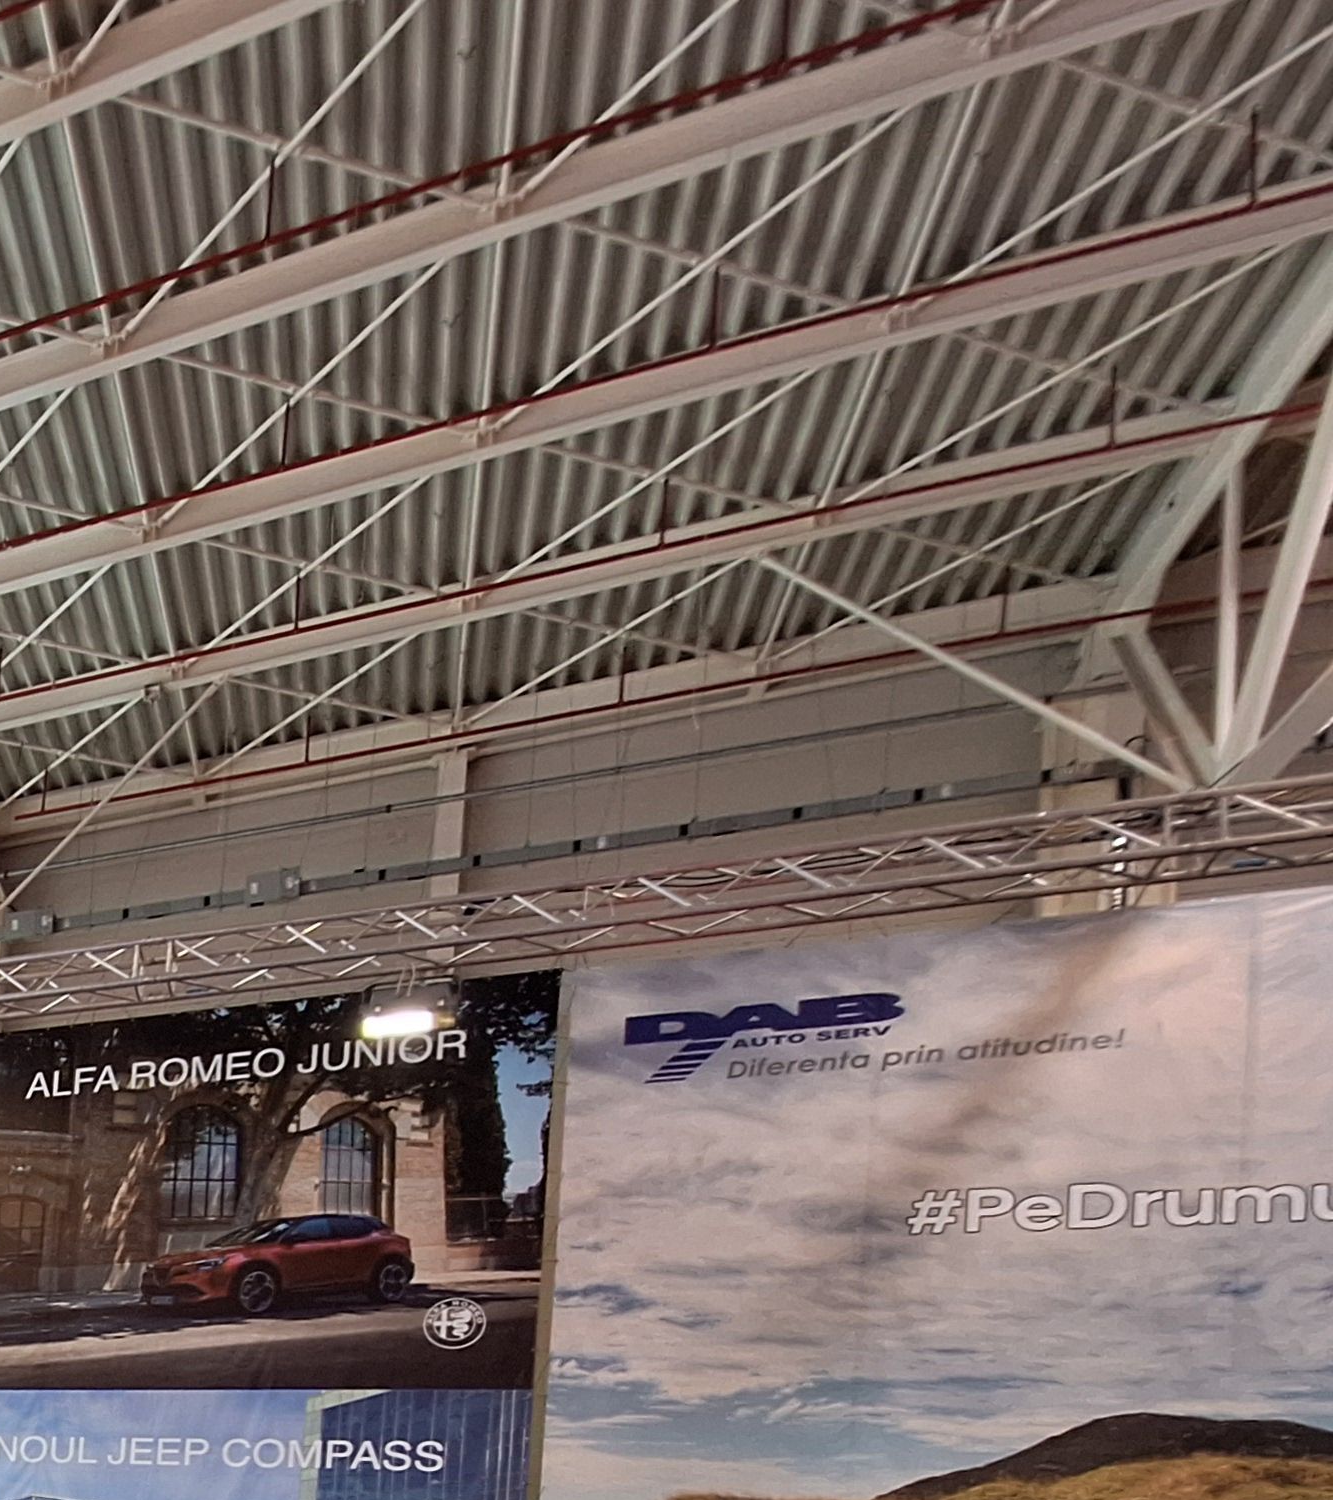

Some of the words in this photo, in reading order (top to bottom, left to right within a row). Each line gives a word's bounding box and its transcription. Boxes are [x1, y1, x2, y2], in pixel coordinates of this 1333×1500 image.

[624, 992, 905, 1046] DAB
[732, 1033, 808, 1050] AUTO
[816, 1025, 892, 1043] SERV
[26, 1067, 119, 1100] ALFA
[130, 1047, 285, 1090] ROMEO
[297, 1029, 468, 1075] JUNIOR
[726, 1051, 871, 1081] Diferenta
[880, 1044, 944, 1072] prin
[957, 1029, 1125, 1061] atitudine!
[107, 1436, 209, 1467] JEEP
[221, 1437, 445, 1473] COMPASS
